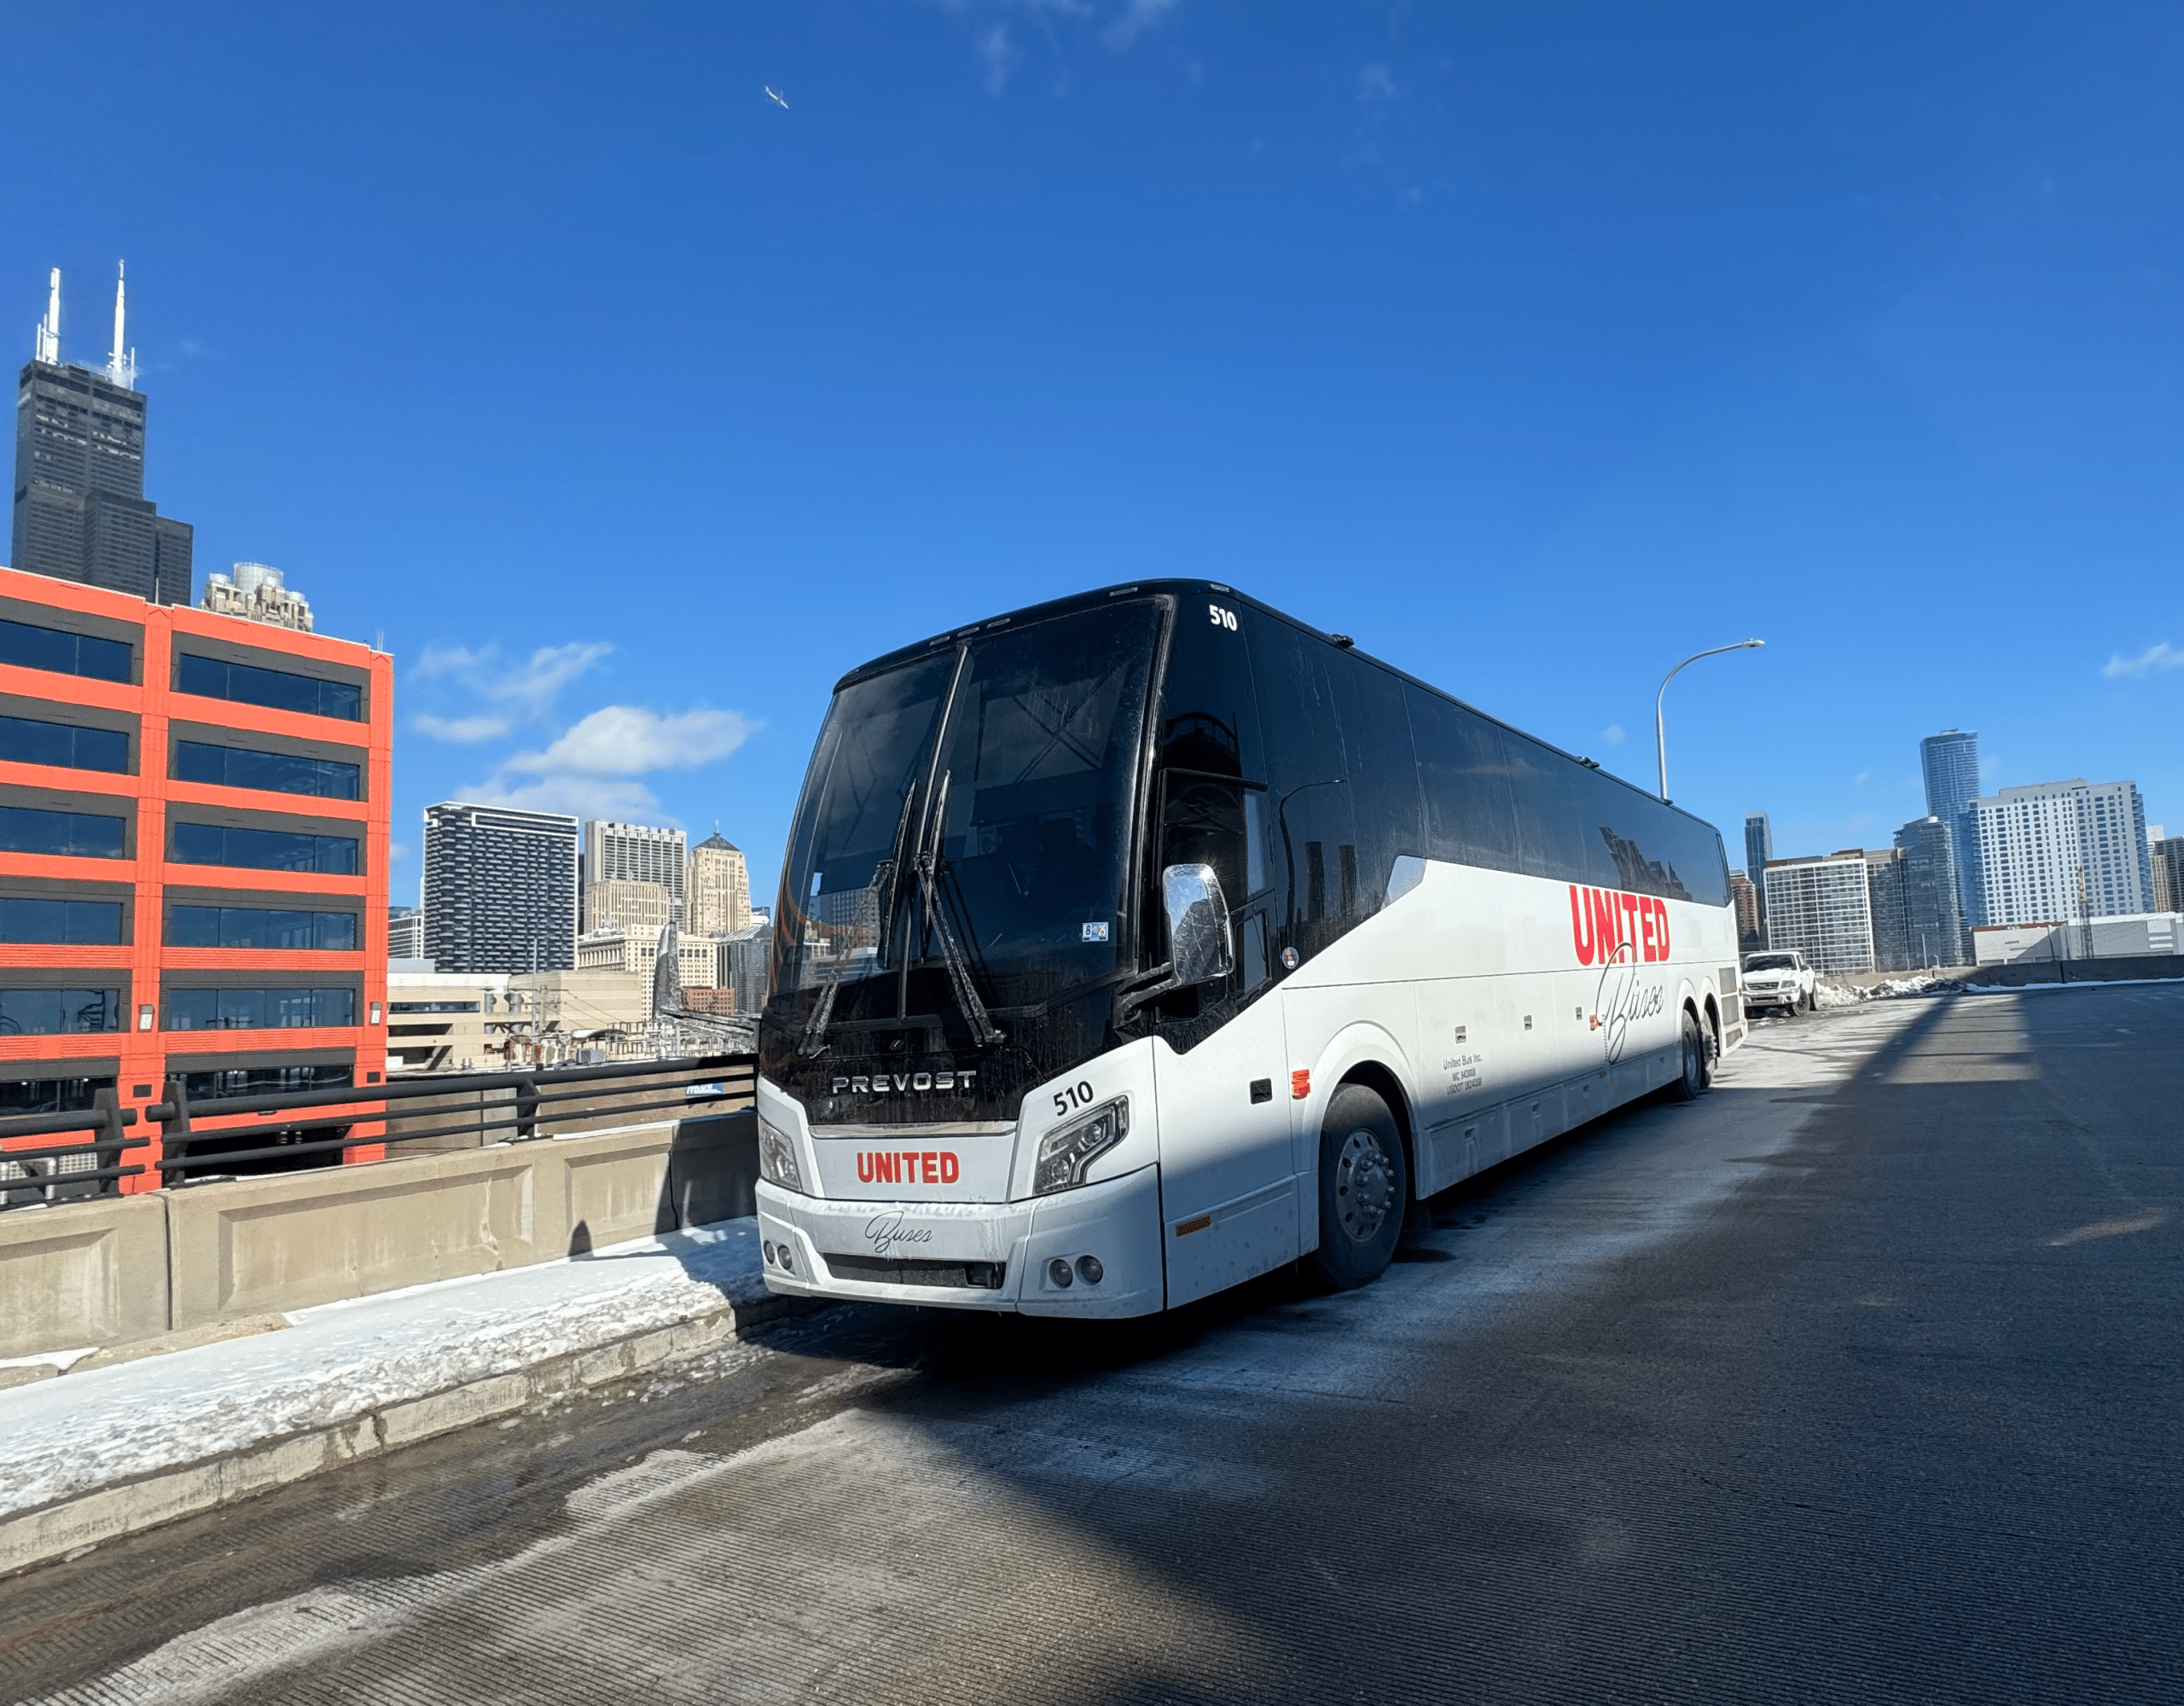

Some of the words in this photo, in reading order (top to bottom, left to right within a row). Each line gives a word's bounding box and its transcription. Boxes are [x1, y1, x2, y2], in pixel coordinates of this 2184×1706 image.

[1209, 604, 1238, 631] 510
[1568, 885, 1670, 966] UNITED
[1595, 942, 1664, 1065] Buses
[1443, 1056, 1461, 1071] United
[1461, 1054, 1472, 1065] Bus
[832, 1070, 978, 1094] PREVOST
[1052, 1080, 1094, 1117] 510
[857, 1151, 960, 1184] UNITED
[863, 1210, 934, 1254] Buses
